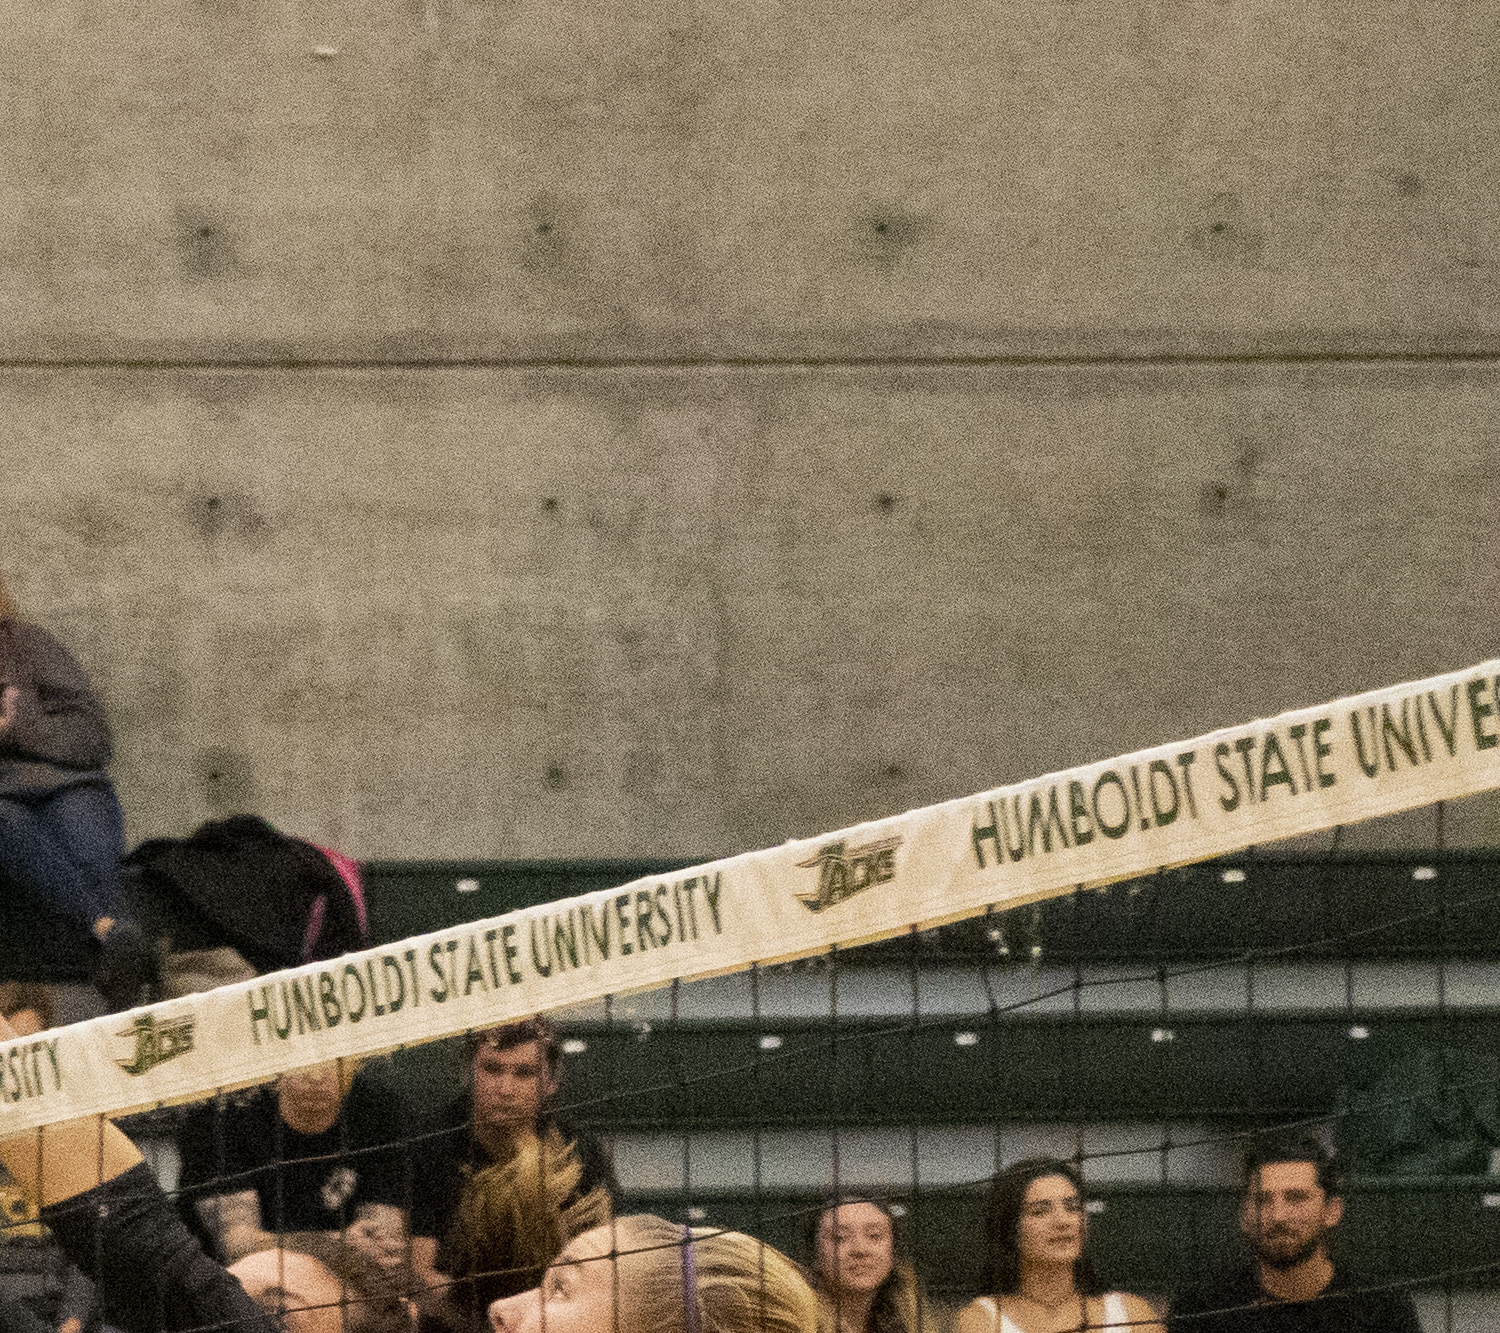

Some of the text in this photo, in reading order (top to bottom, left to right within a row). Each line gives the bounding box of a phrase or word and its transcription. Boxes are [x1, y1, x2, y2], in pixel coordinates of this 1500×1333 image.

[971, 674, 1500, 869] HUMBOLDT STATE UNIVE
[429, 921, 523, 1003] STATE
[530, 871, 725, 977] UNIVERSITY
